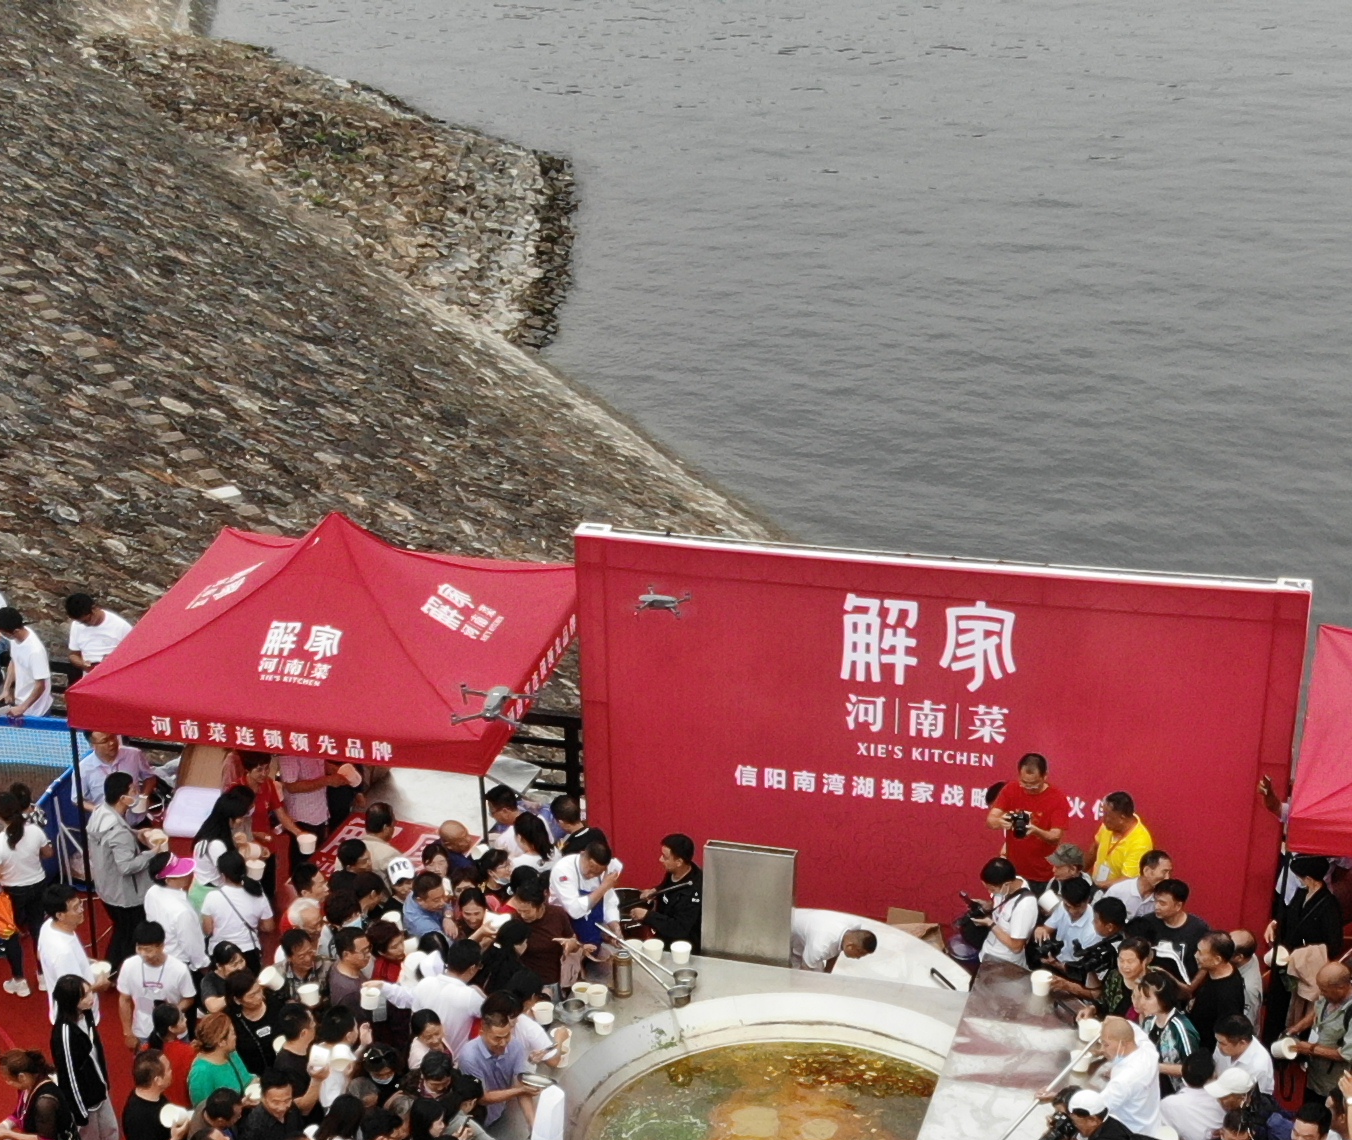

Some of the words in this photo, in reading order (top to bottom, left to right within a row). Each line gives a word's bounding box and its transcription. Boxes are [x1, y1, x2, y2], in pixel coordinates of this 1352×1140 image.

[260, 620, 343, 660] 解家
[839, 592, 1017, 693] 解家
[283, 676, 321, 687] KITCHEN
[151, 715, 393, 762] 河南菜连锁领先品牌
[856, 741, 904, 760] XIE'S
[911, 746, 995, 768] KITCHEN
